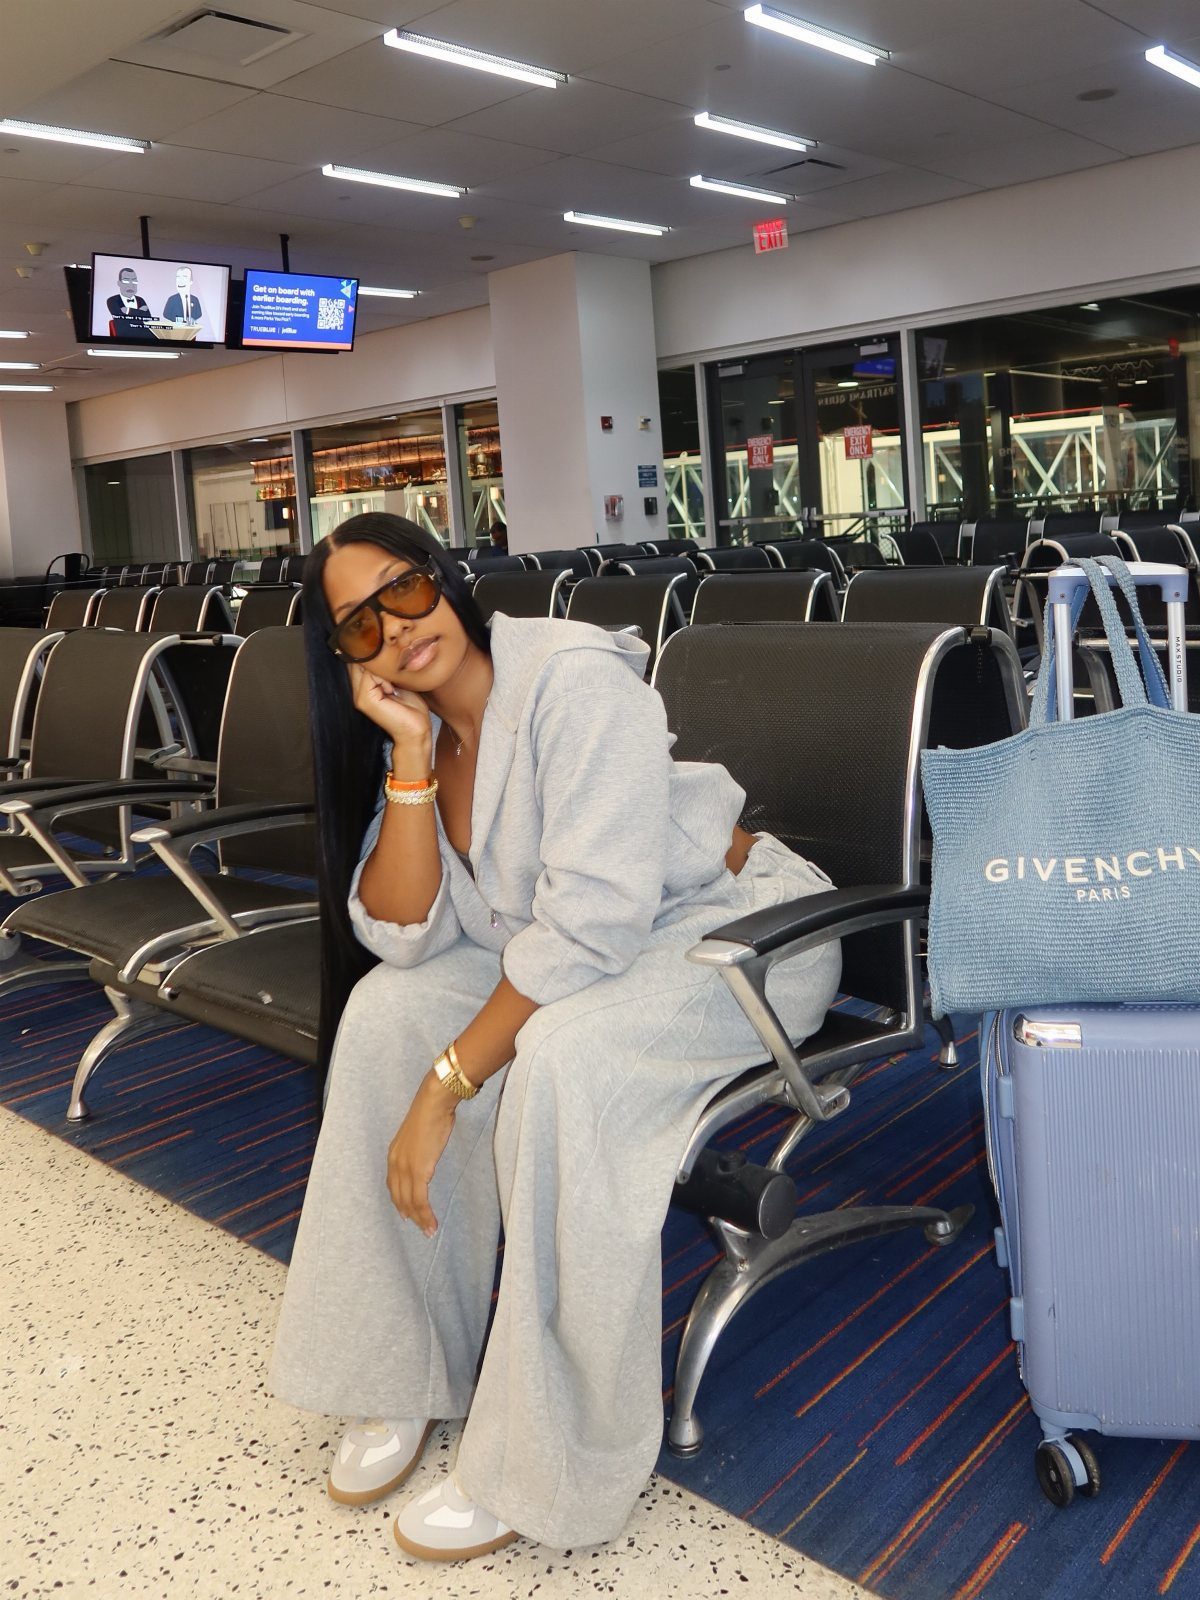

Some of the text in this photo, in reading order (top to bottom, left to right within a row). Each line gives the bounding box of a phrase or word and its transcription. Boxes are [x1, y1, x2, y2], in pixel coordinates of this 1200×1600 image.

[758, 231, 783, 251] EXIT
[253, 284, 267, 294] Get
[278, 287, 299, 296] board
[299, 288, 316, 297] with
[252, 294, 309, 306] earlier boarding.
[850, 435, 867, 446] EXIT
[753, 445, 768, 456] EXIT
[850, 445, 868, 456] ONLY
[753, 454, 769, 465] ONLY
[1077, 885, 1131, 903] PARIS
